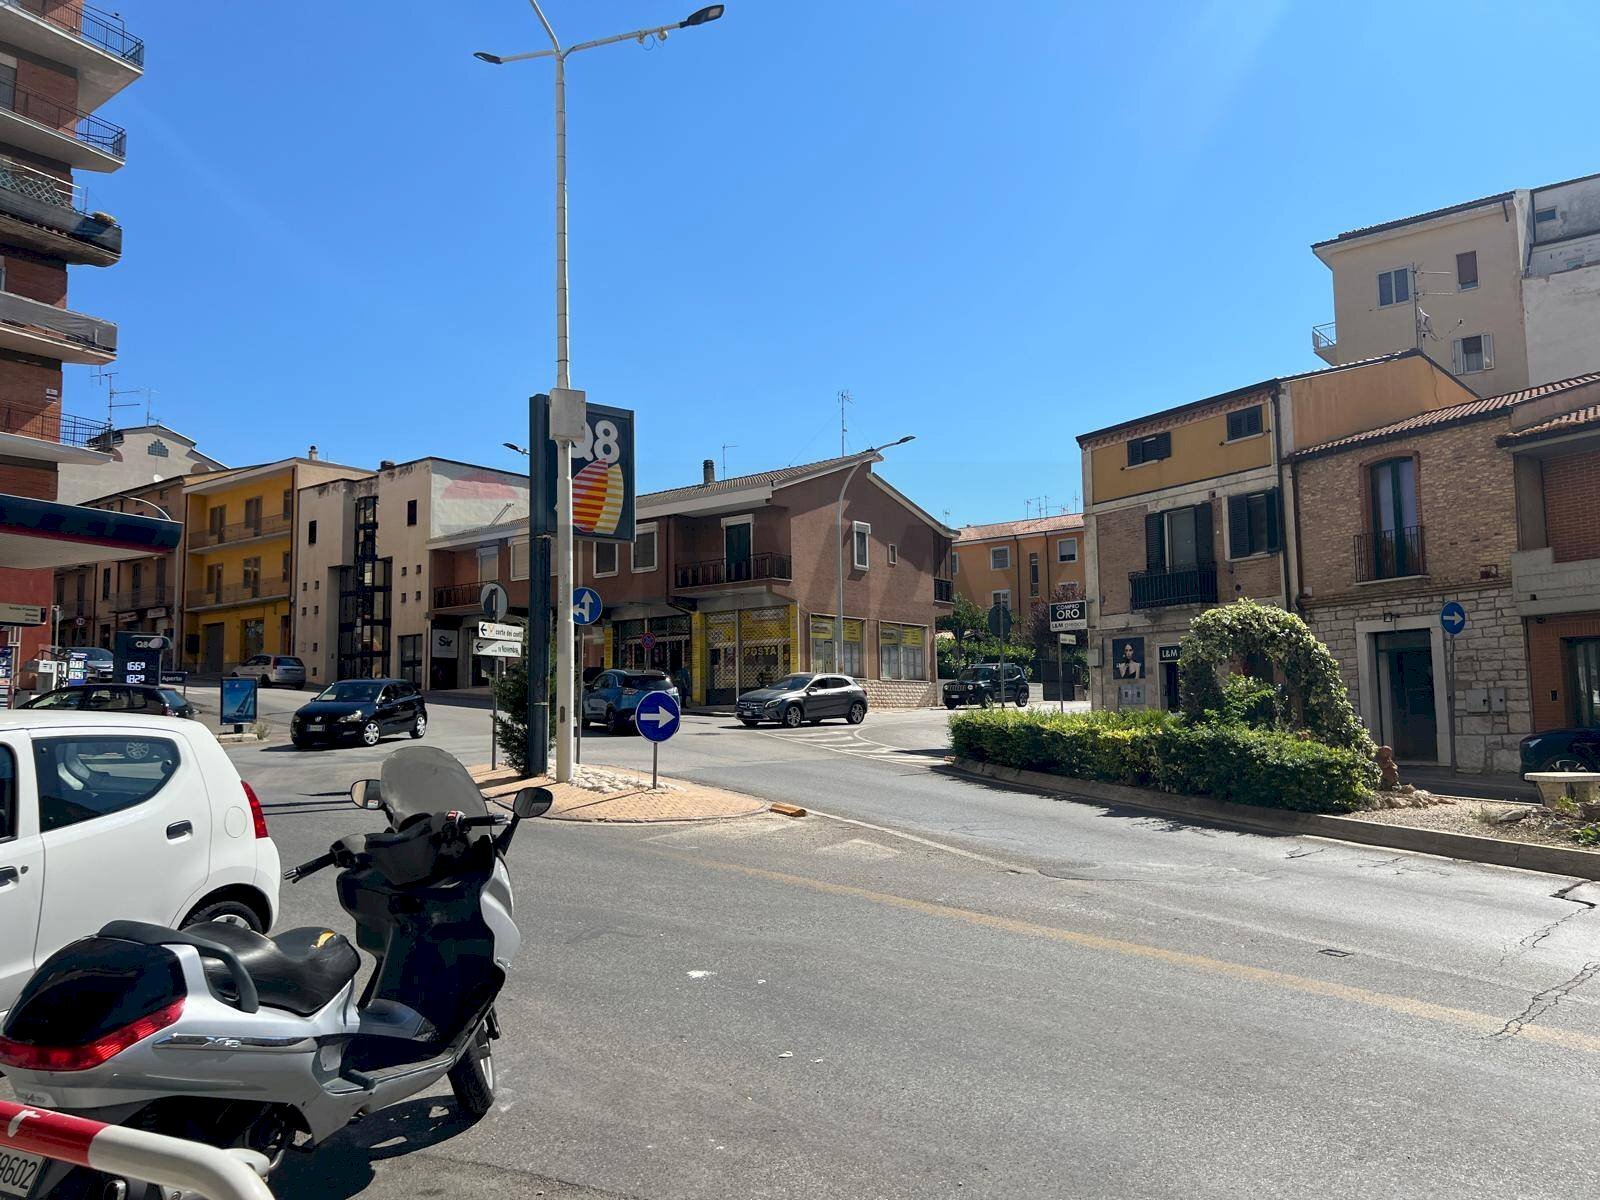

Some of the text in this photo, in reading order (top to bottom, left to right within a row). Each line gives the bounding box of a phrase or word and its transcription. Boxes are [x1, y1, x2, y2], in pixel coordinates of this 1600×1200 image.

[1056, 603, 1080, 611] COMPRO
[1056, 608, 1080, 620] ORO
[744, 646, 777, 657] POSTA
[1162, 649, 1178, 658] L&M
